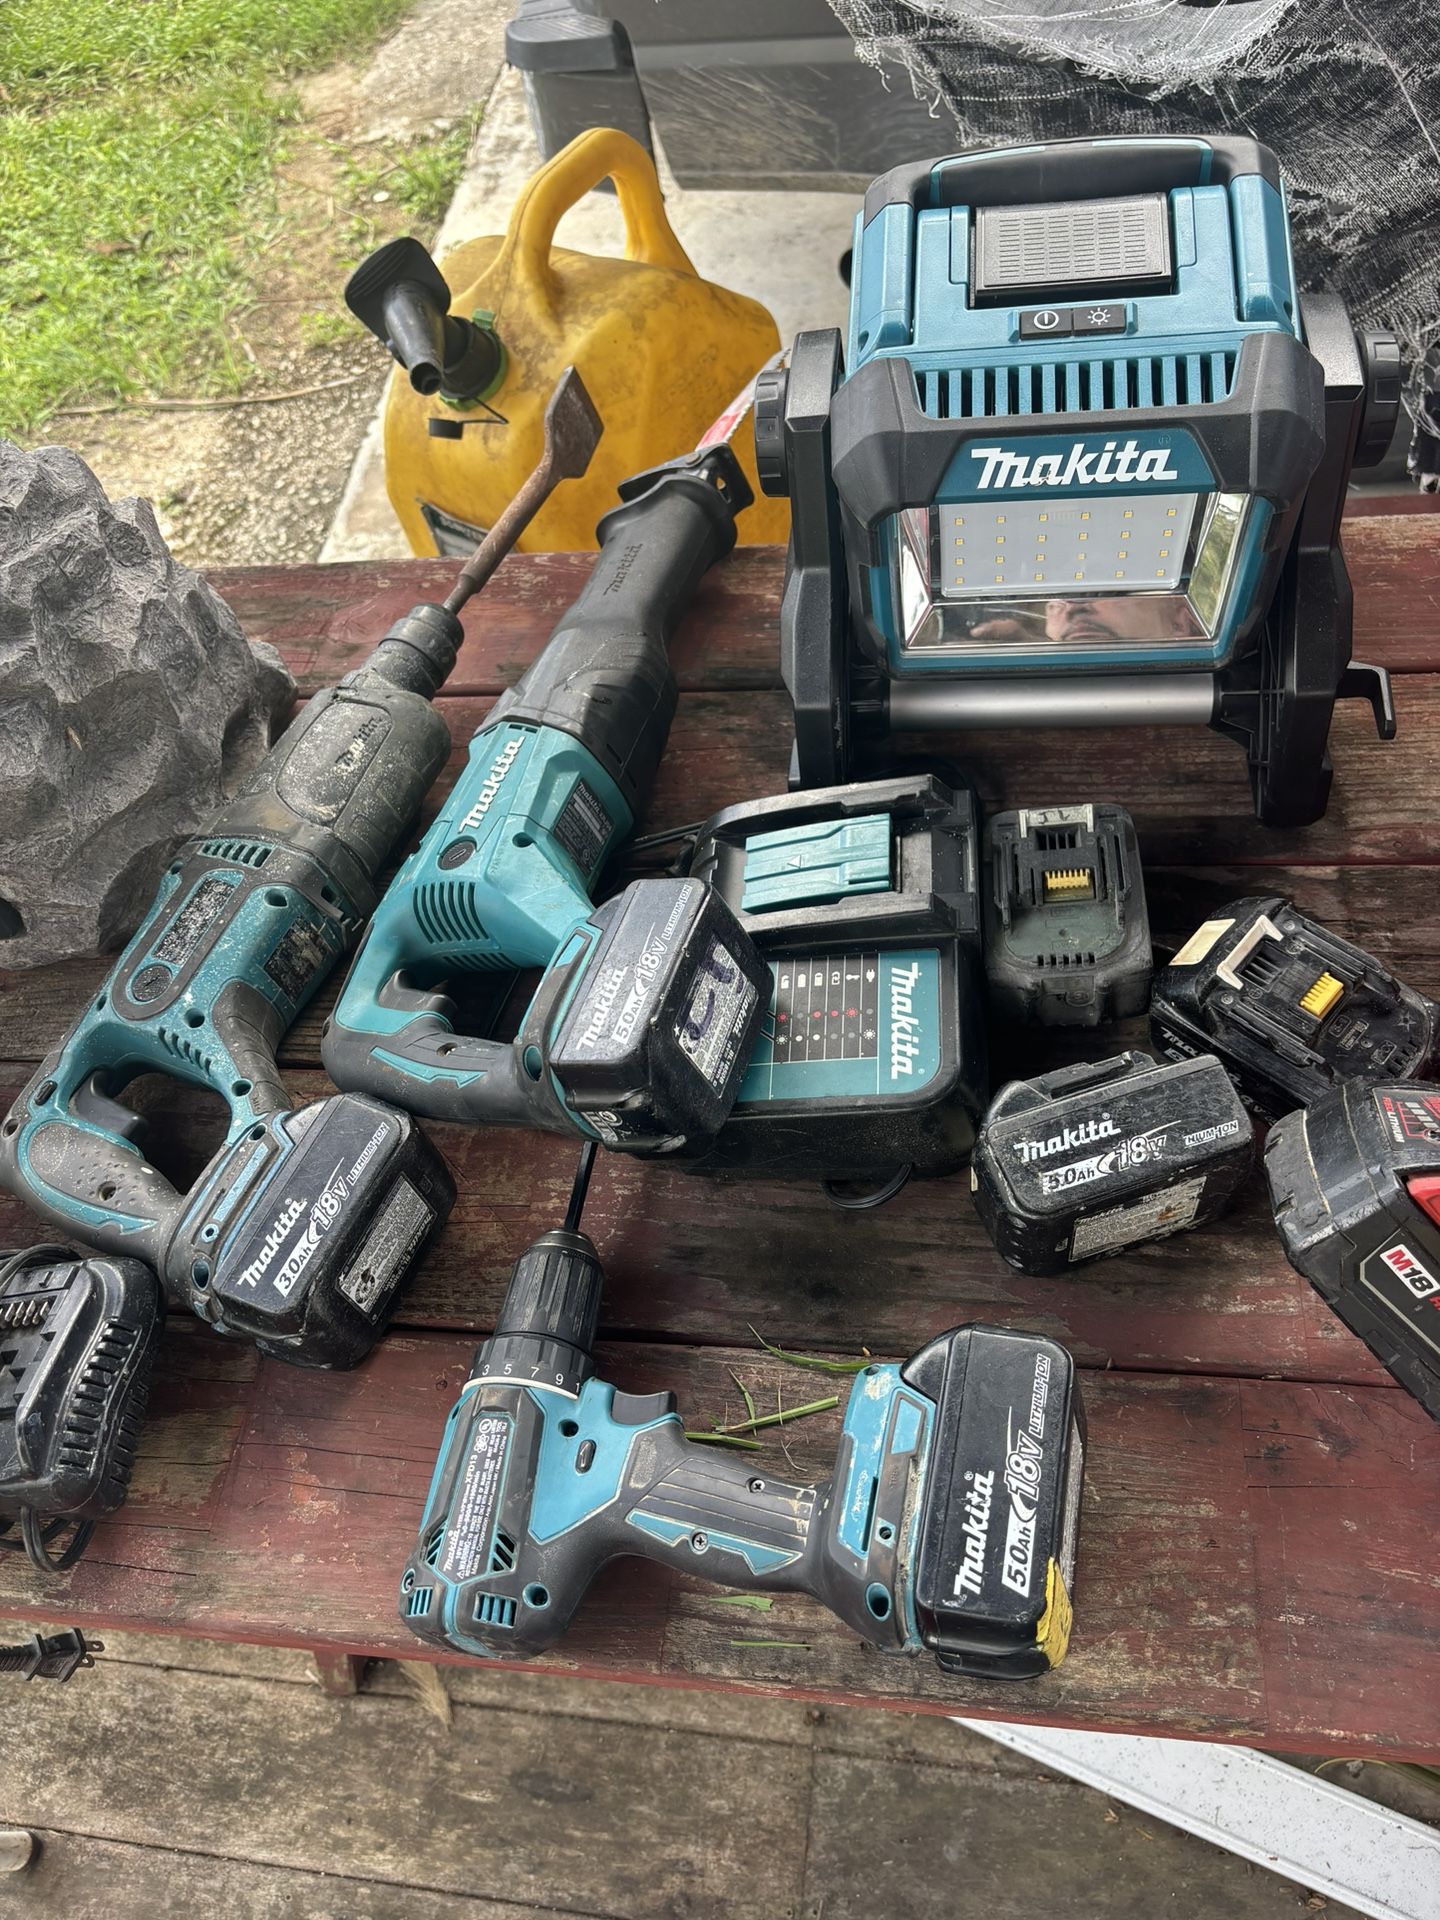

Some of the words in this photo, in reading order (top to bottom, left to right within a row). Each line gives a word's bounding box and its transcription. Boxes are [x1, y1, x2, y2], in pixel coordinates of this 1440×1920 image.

[635, 937, 667, 982] 18V
[616, 999, 643, 1039] 5.0Ah
[310, 1176, 350, 1231] 18V
[279, 1246, 313, 1290] 3.0Ah
[1386, 1249, 1434, 1292] M18
[482, 1364, 490, 1376] 3
[503, 1363, 512, 1375] 5
[530, 1366, 540, 1378] 7
[555, 1373, 564, 1385] 9
[464, 1453, 477, 1484] XFD13
[1004, 1430, 1043, 1501] 18V
[1008, 1527, 1032, 1587] 5.0Ah
